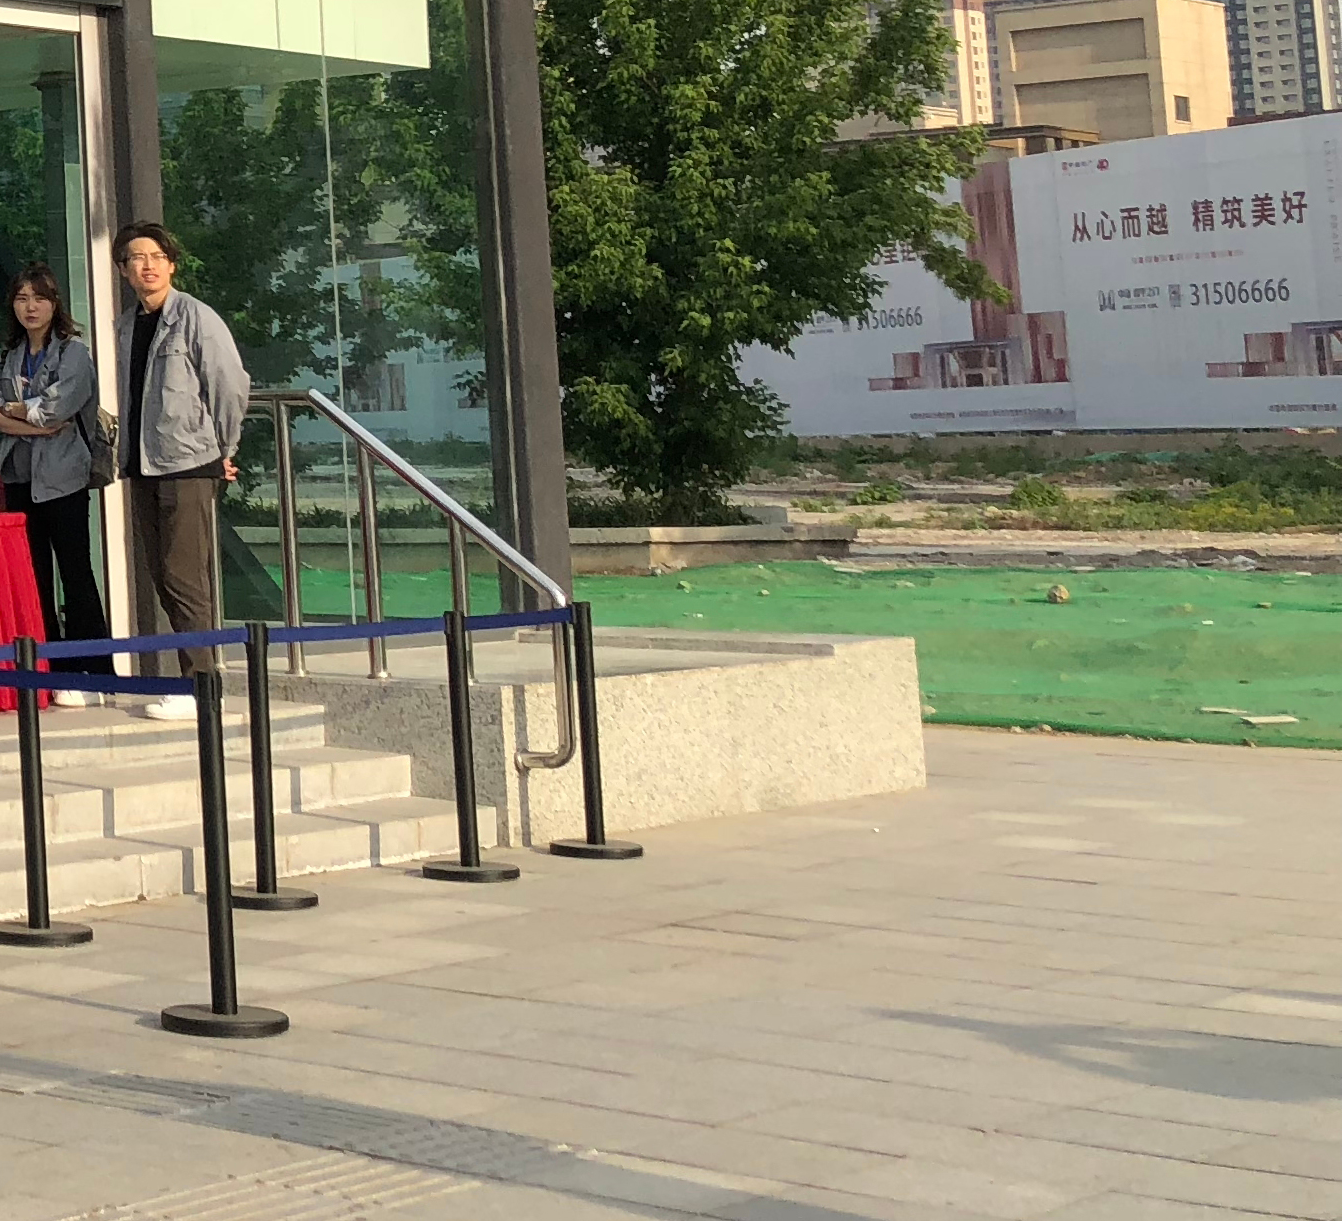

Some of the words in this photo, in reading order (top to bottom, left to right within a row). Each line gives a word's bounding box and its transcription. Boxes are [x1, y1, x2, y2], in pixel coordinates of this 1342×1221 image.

[1072, 203, 1170, 243] 从心而越
[1191, 190, 1308, 233] 精筑美好
[1189, 277, 1290, 306] 31506666
